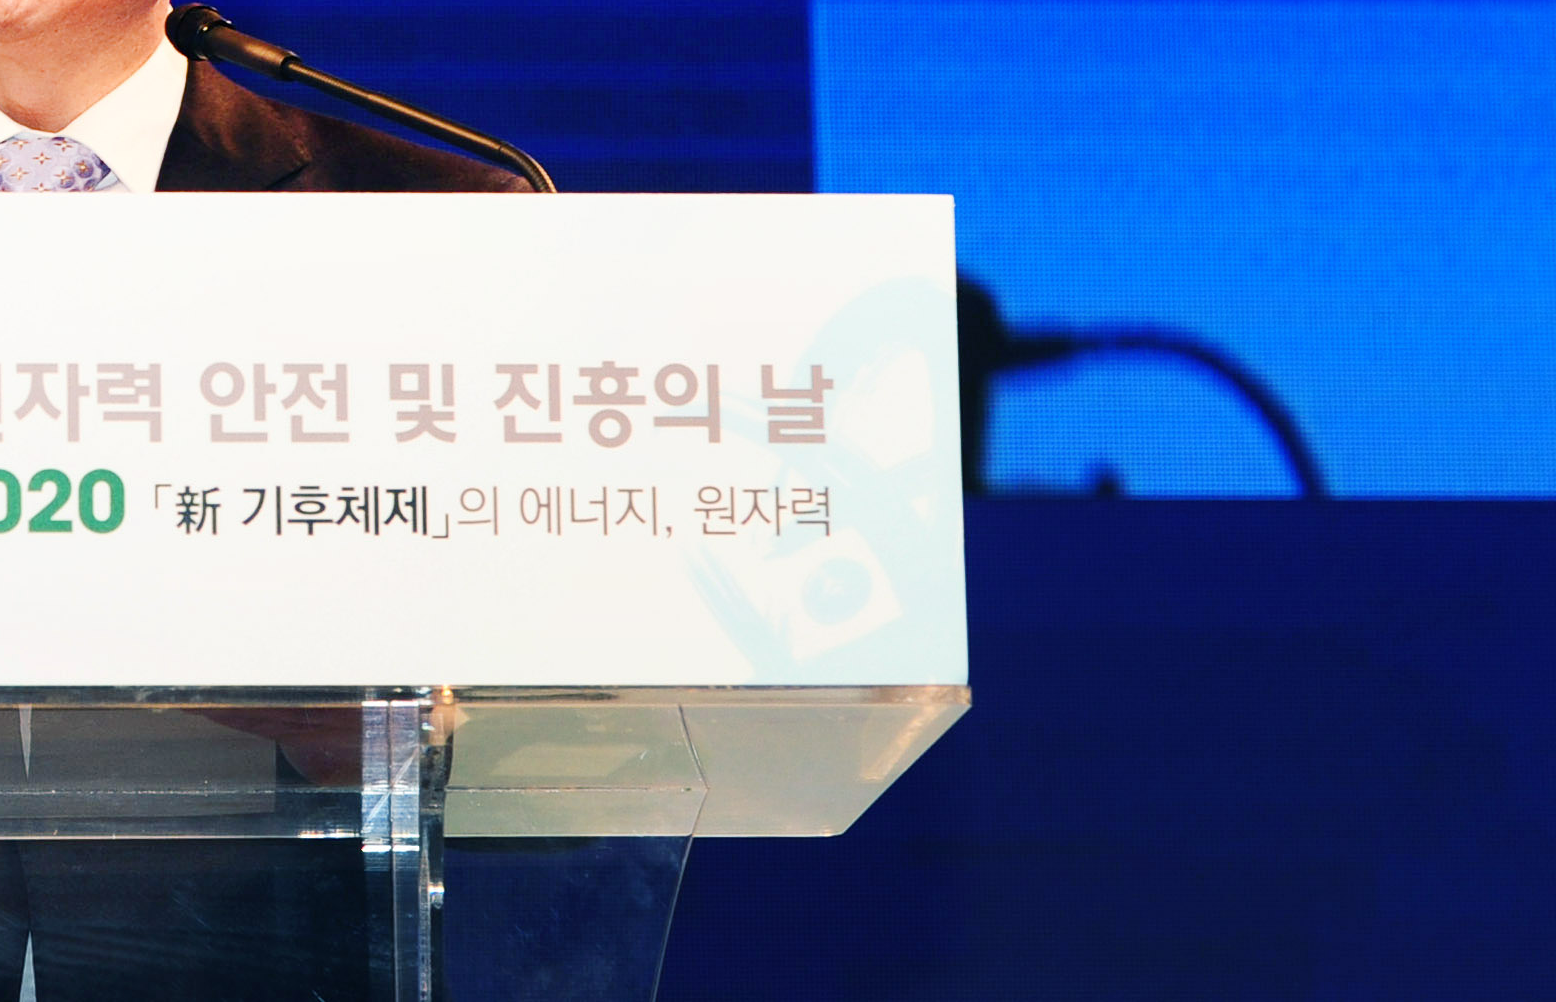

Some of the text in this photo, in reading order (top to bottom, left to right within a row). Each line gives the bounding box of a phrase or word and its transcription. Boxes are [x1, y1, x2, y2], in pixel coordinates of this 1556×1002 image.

[199, 361, 351, 444] 안전
[388, 363, 458, 444] 및
[493, 360, 722, 449] 진흥의
[760, 363, 835, 445] 날
[240, 484, 500, 541] 기후체제」의
[518, 485, 674, 540] 에너지,
[692, 484, 837, 538] 원자력
